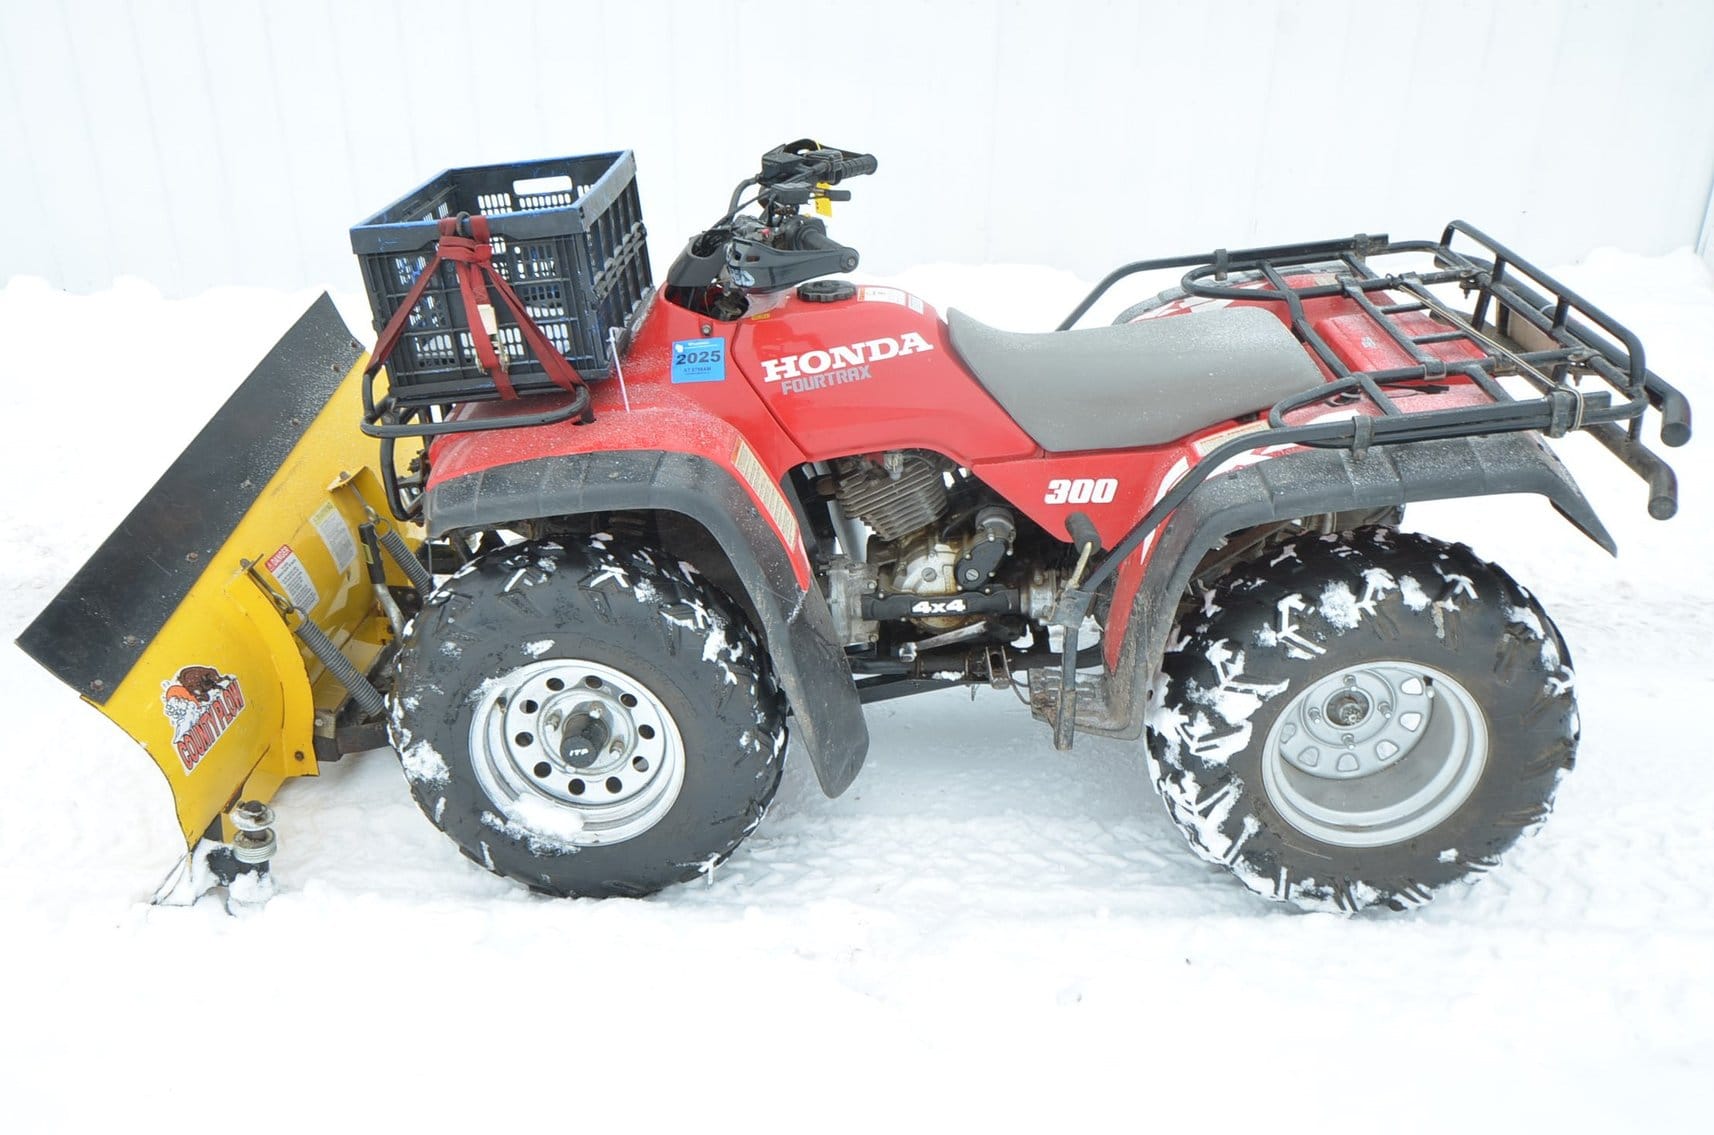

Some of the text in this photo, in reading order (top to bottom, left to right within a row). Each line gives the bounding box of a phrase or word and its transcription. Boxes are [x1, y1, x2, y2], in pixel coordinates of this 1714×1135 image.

[675, 350, 721, 366] 2025
[760, 331, 934, 383] HONDA
[781, 364, 873, 395] FOURTRAX
[1044, 478, 1119, 505] 300
[912, 599, 967, 614] 4x4
[177, 679, 244, 771] COUNTY PLOW
[569, 748, 589, 757] ITP
